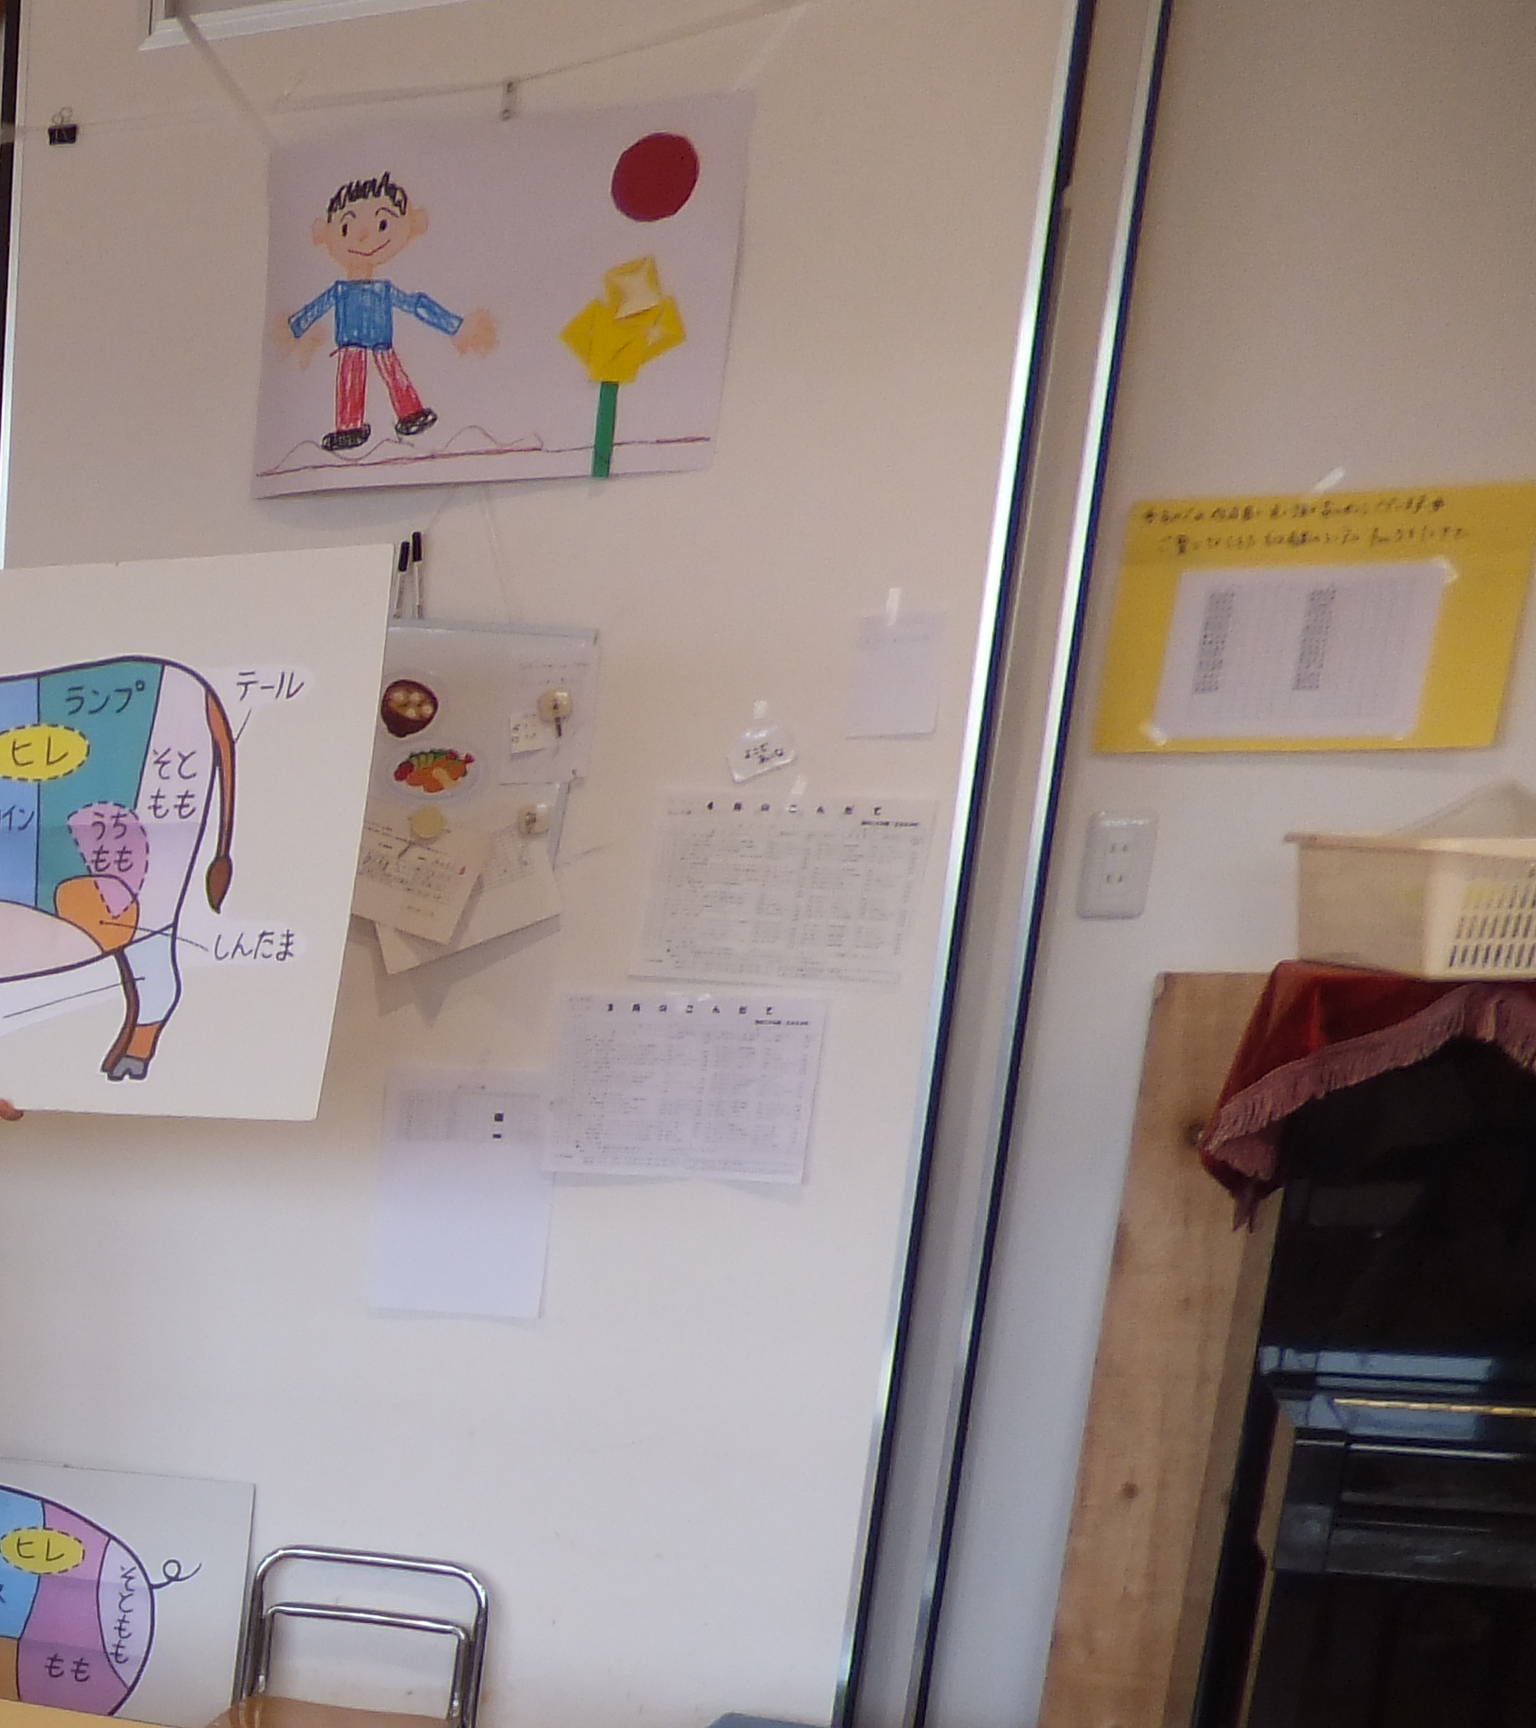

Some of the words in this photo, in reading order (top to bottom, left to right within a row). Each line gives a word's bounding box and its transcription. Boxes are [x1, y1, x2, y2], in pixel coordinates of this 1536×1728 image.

[64, 678, 146, 717] ランプ
[235, 670, 305, 701] テール
[10, 735, 69, 767] ヒレ
[152, 746, 198, 781] そと
[146, 787, 198, 820] もも
[90, 811, 128, 841] うち
[90, 848, 134, 874] もも
[212, 927, 297, 961] しんたま
[15, 1536, 67, 1564] ヒレ
[110, 1564, 137, 1666] そともも
[44, 1651, 92, 1683] もも
